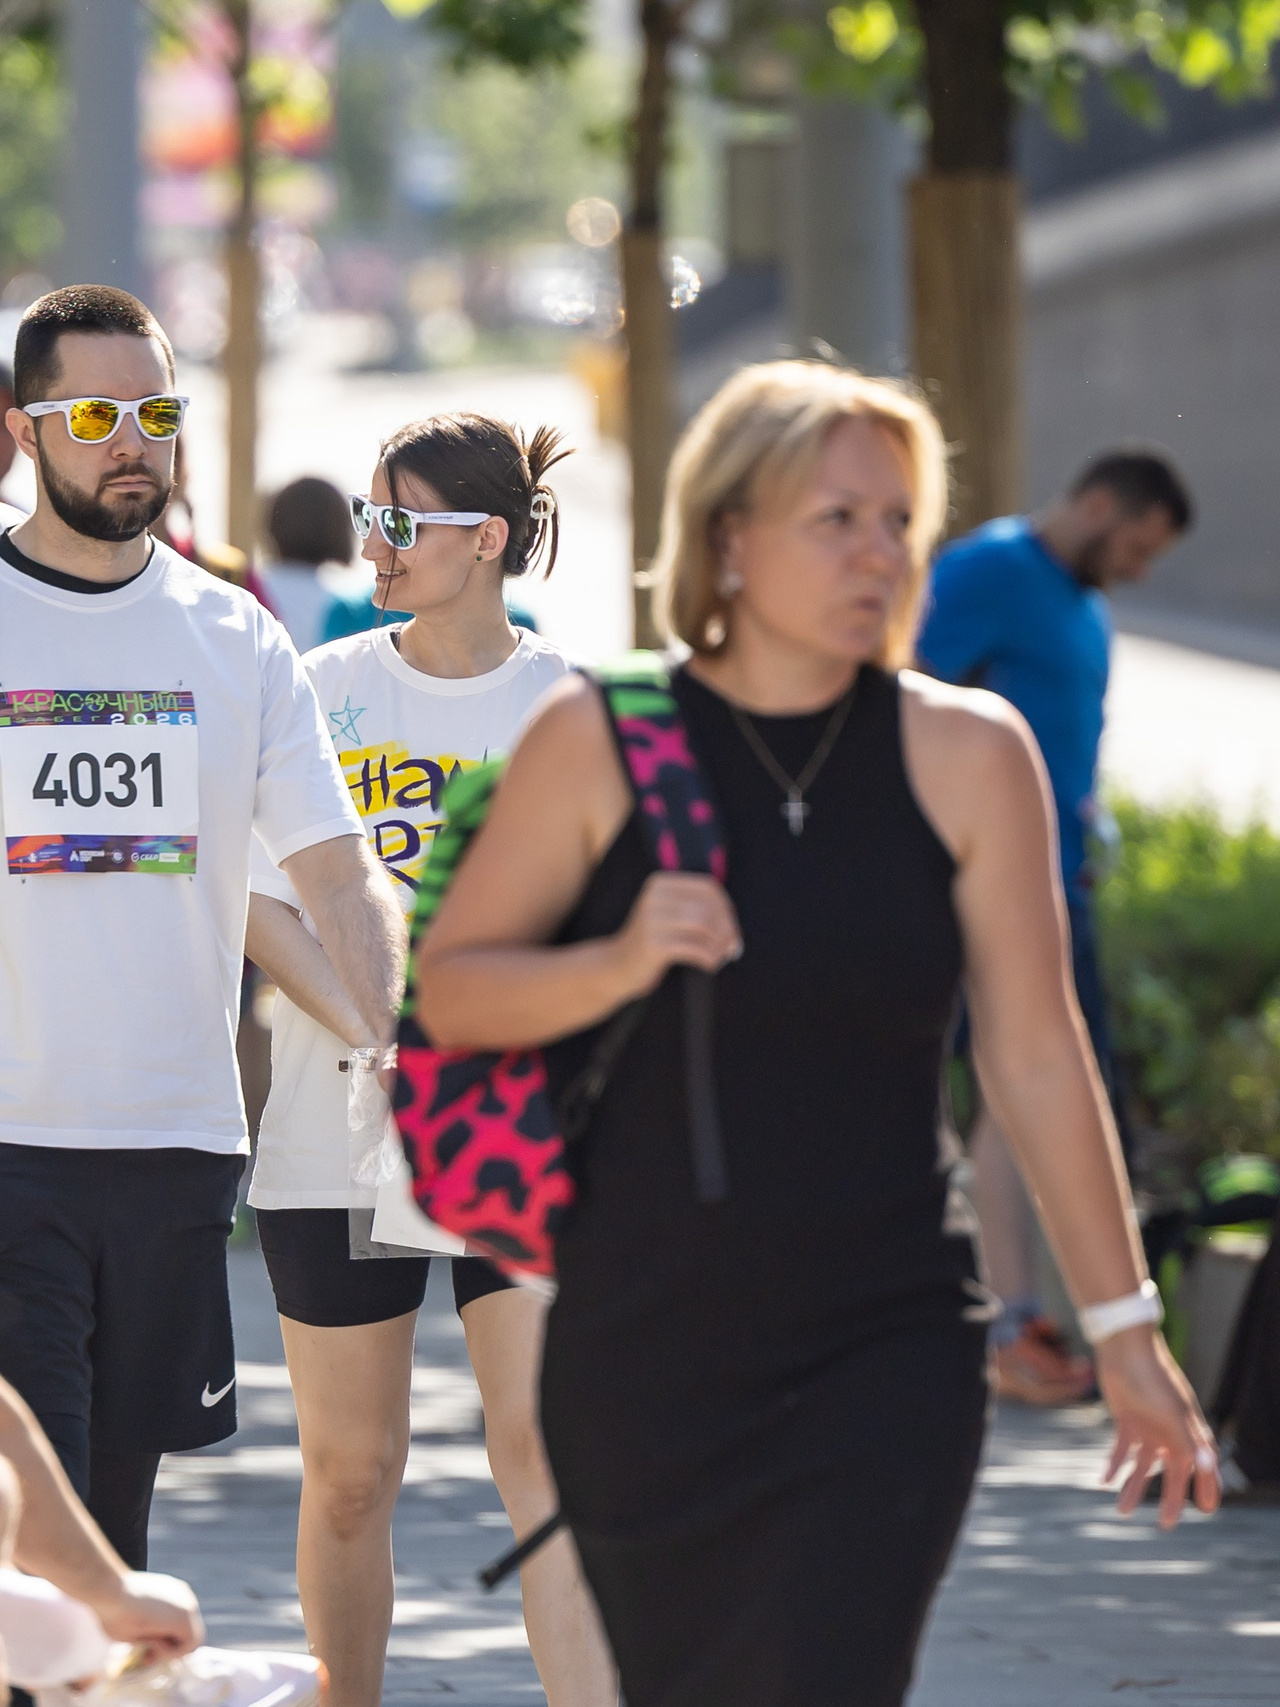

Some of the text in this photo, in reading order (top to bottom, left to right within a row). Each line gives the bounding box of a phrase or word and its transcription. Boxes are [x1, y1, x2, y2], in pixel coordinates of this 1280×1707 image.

[12, 690, 179, 714] КРАСОЧНЫЙ
[110, 713, 195, 725] 2026
[32, 752, 163, 808] 4031
